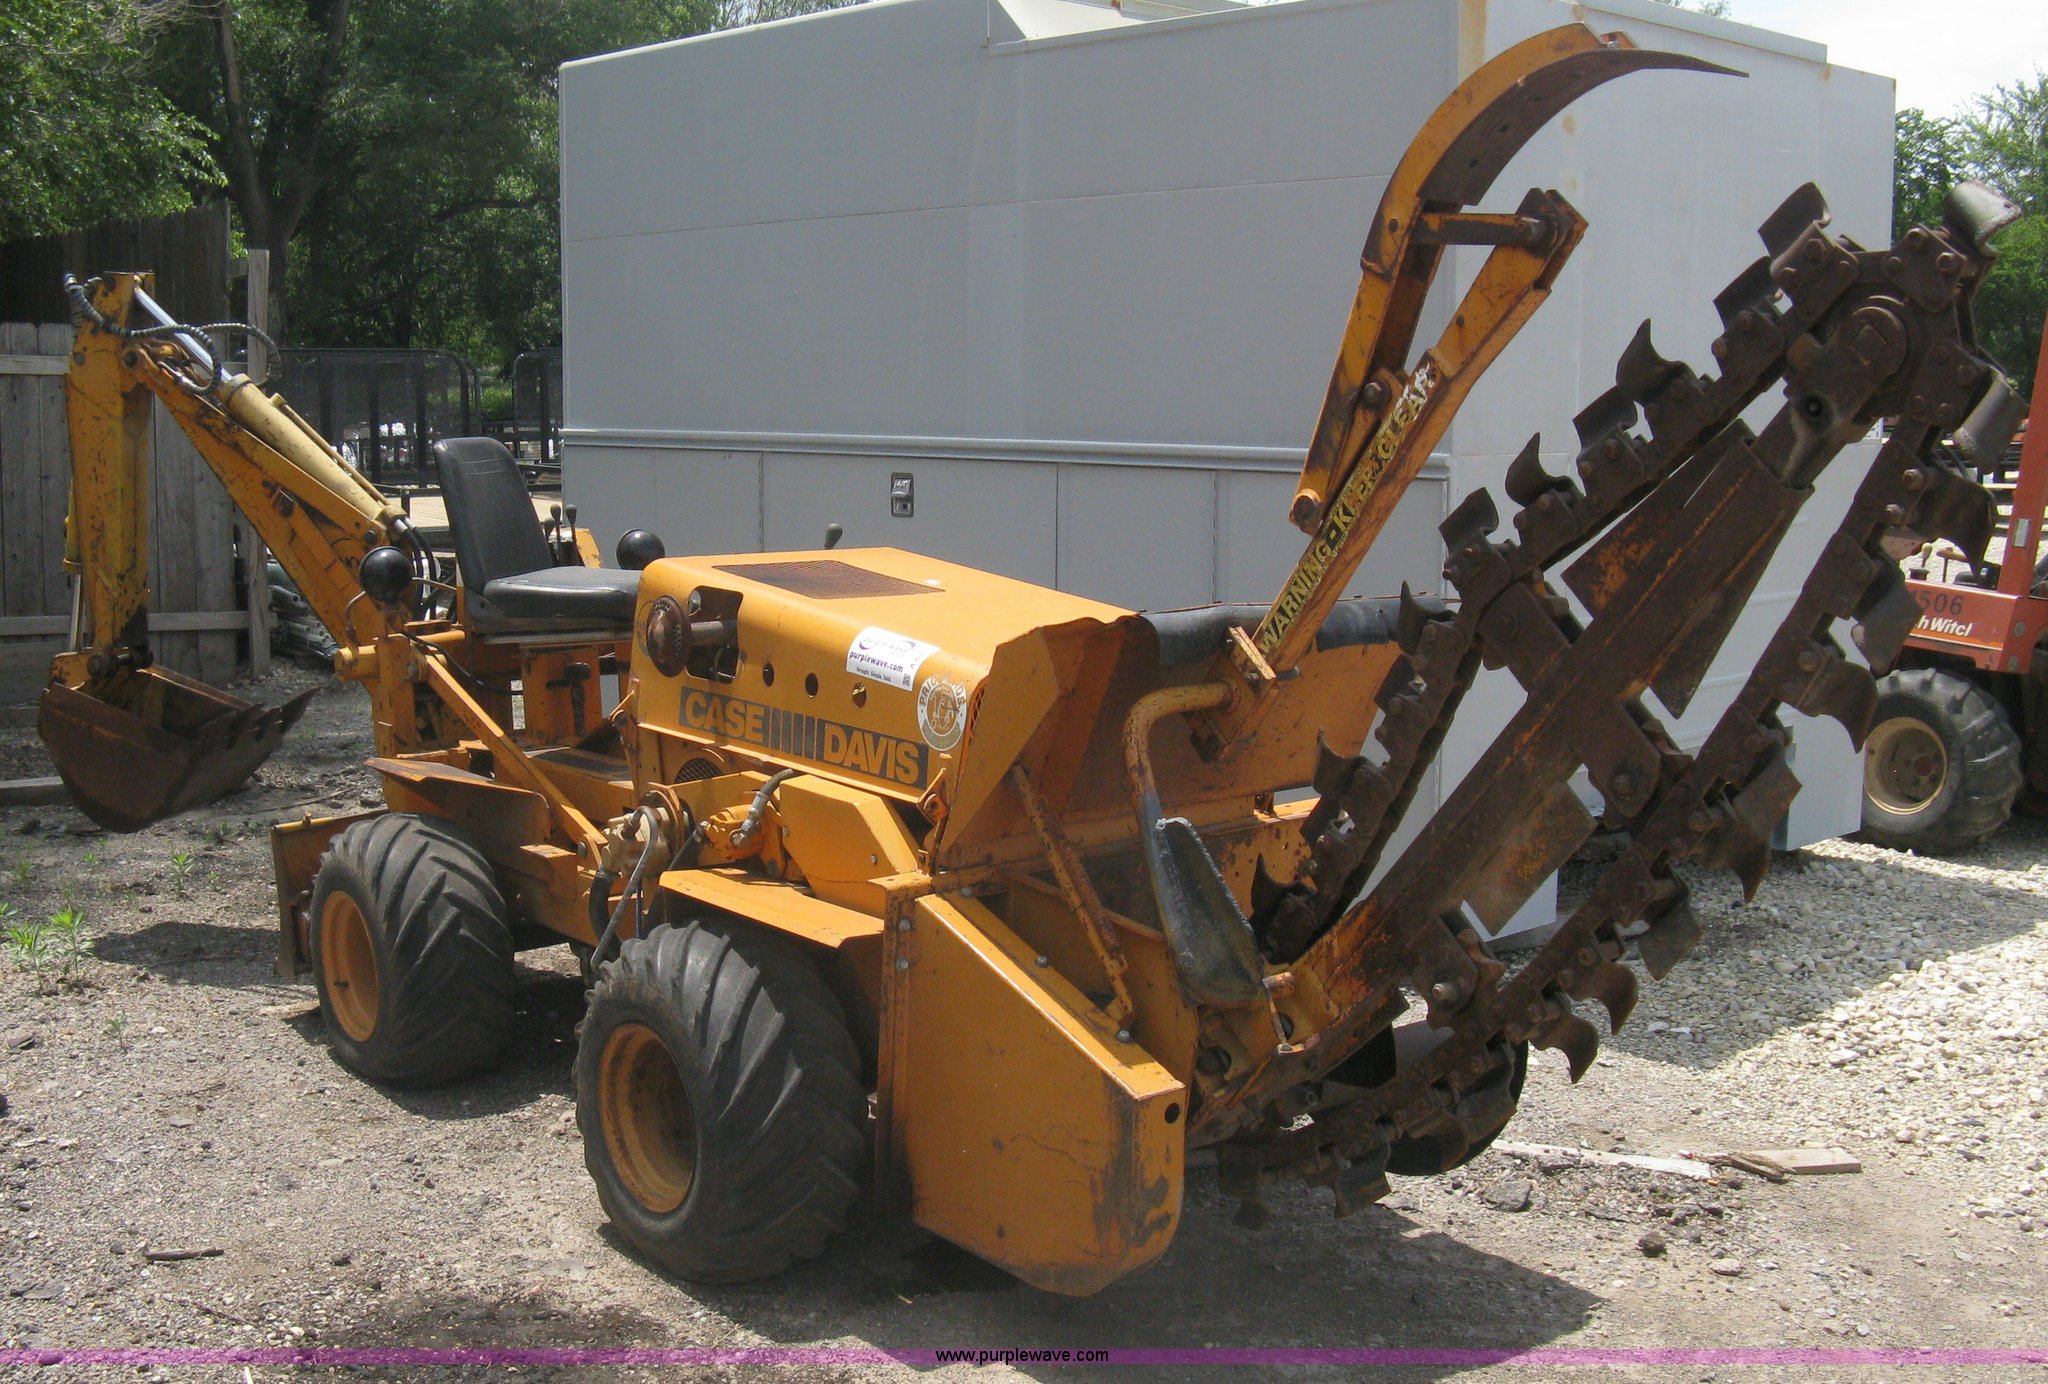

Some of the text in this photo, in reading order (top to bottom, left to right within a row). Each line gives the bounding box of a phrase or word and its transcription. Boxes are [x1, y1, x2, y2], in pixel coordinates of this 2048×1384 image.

[1257, 538, 1333, 650] WARNING
[1913, 589, 1964, 615] 506
[849, 651, 904, 672] purplewave.com
[686, 691, 764, 743] CASE
[824, 723, 920, 785] DAVIS
